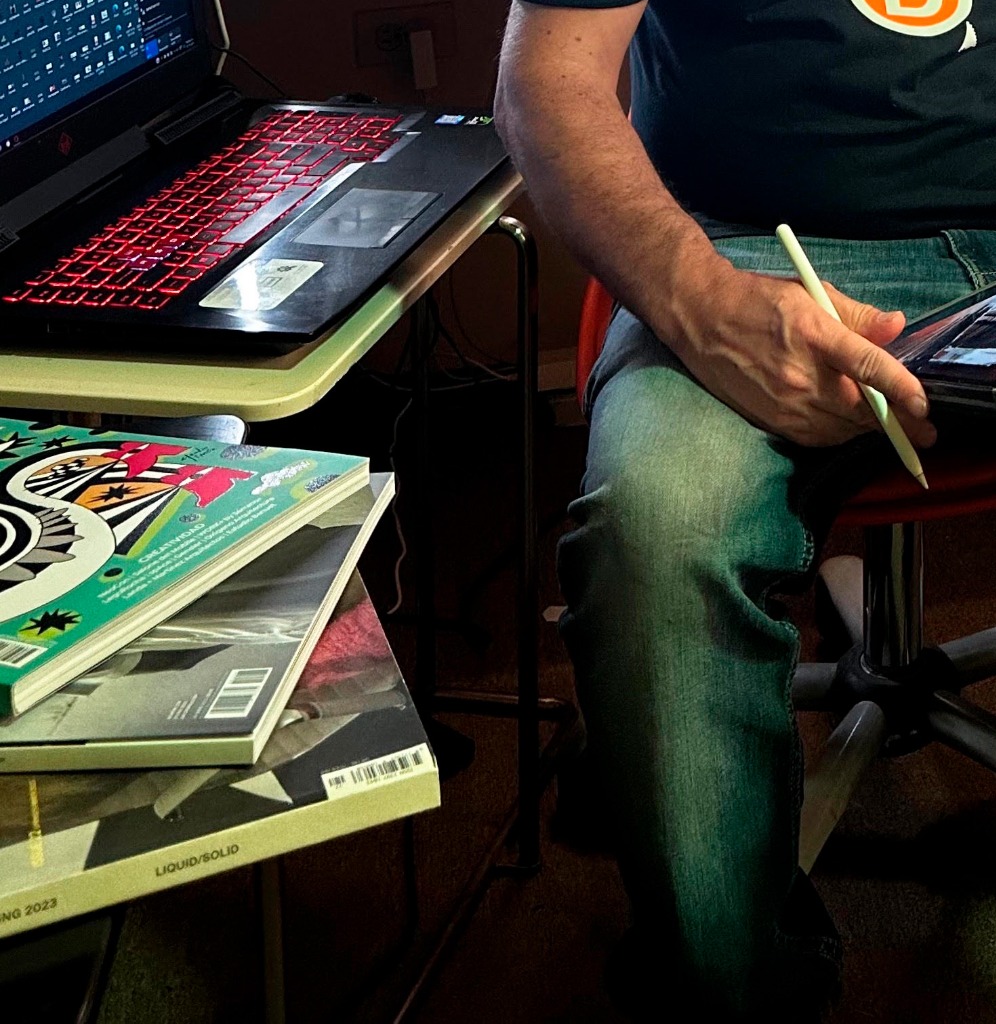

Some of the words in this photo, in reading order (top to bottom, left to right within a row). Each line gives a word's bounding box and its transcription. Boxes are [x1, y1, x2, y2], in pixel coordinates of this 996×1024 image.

[138, 523, 206, 563] CREATIVIDAD
[154, 843, 240, 878] LIQUID/SOLID
[24, 897, 58, 917] 2023
